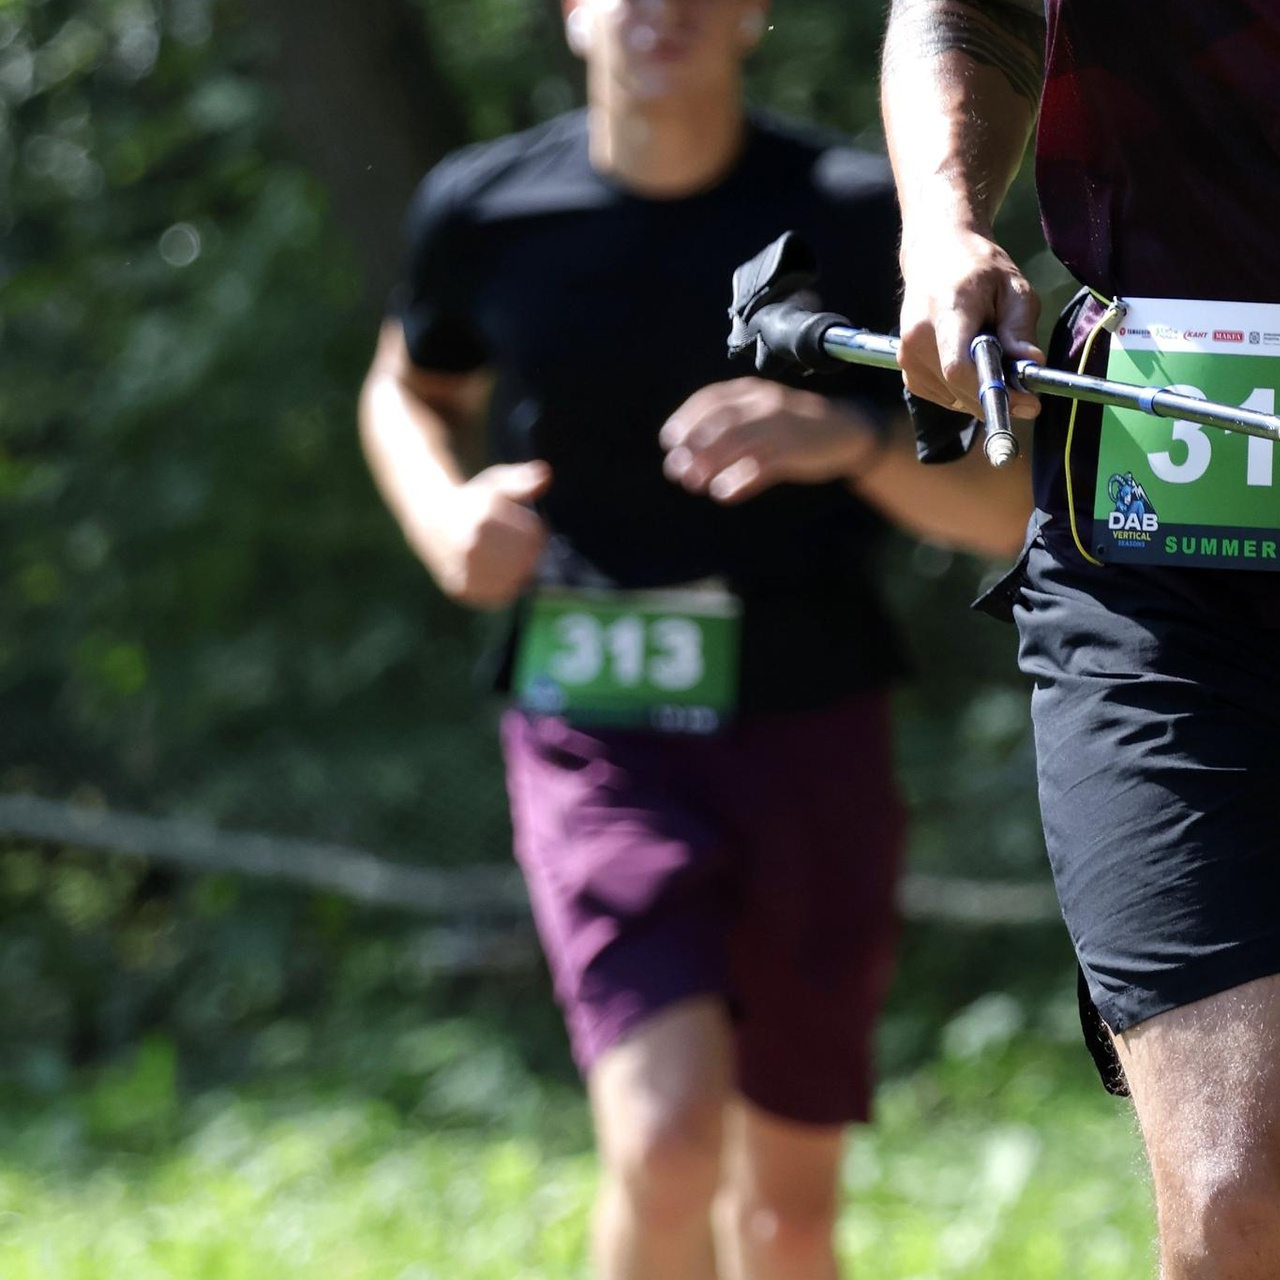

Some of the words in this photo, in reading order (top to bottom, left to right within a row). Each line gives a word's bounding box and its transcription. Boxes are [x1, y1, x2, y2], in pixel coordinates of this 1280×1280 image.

[1186, 330, 1208, 339] KANT
[1108, 511, 1159, 531] DAB
[1112, 531, 1151, 541] VERTICAL
[1165, 535, 1277, 559] SUMMER
[552, 612, 704, 690] 313
